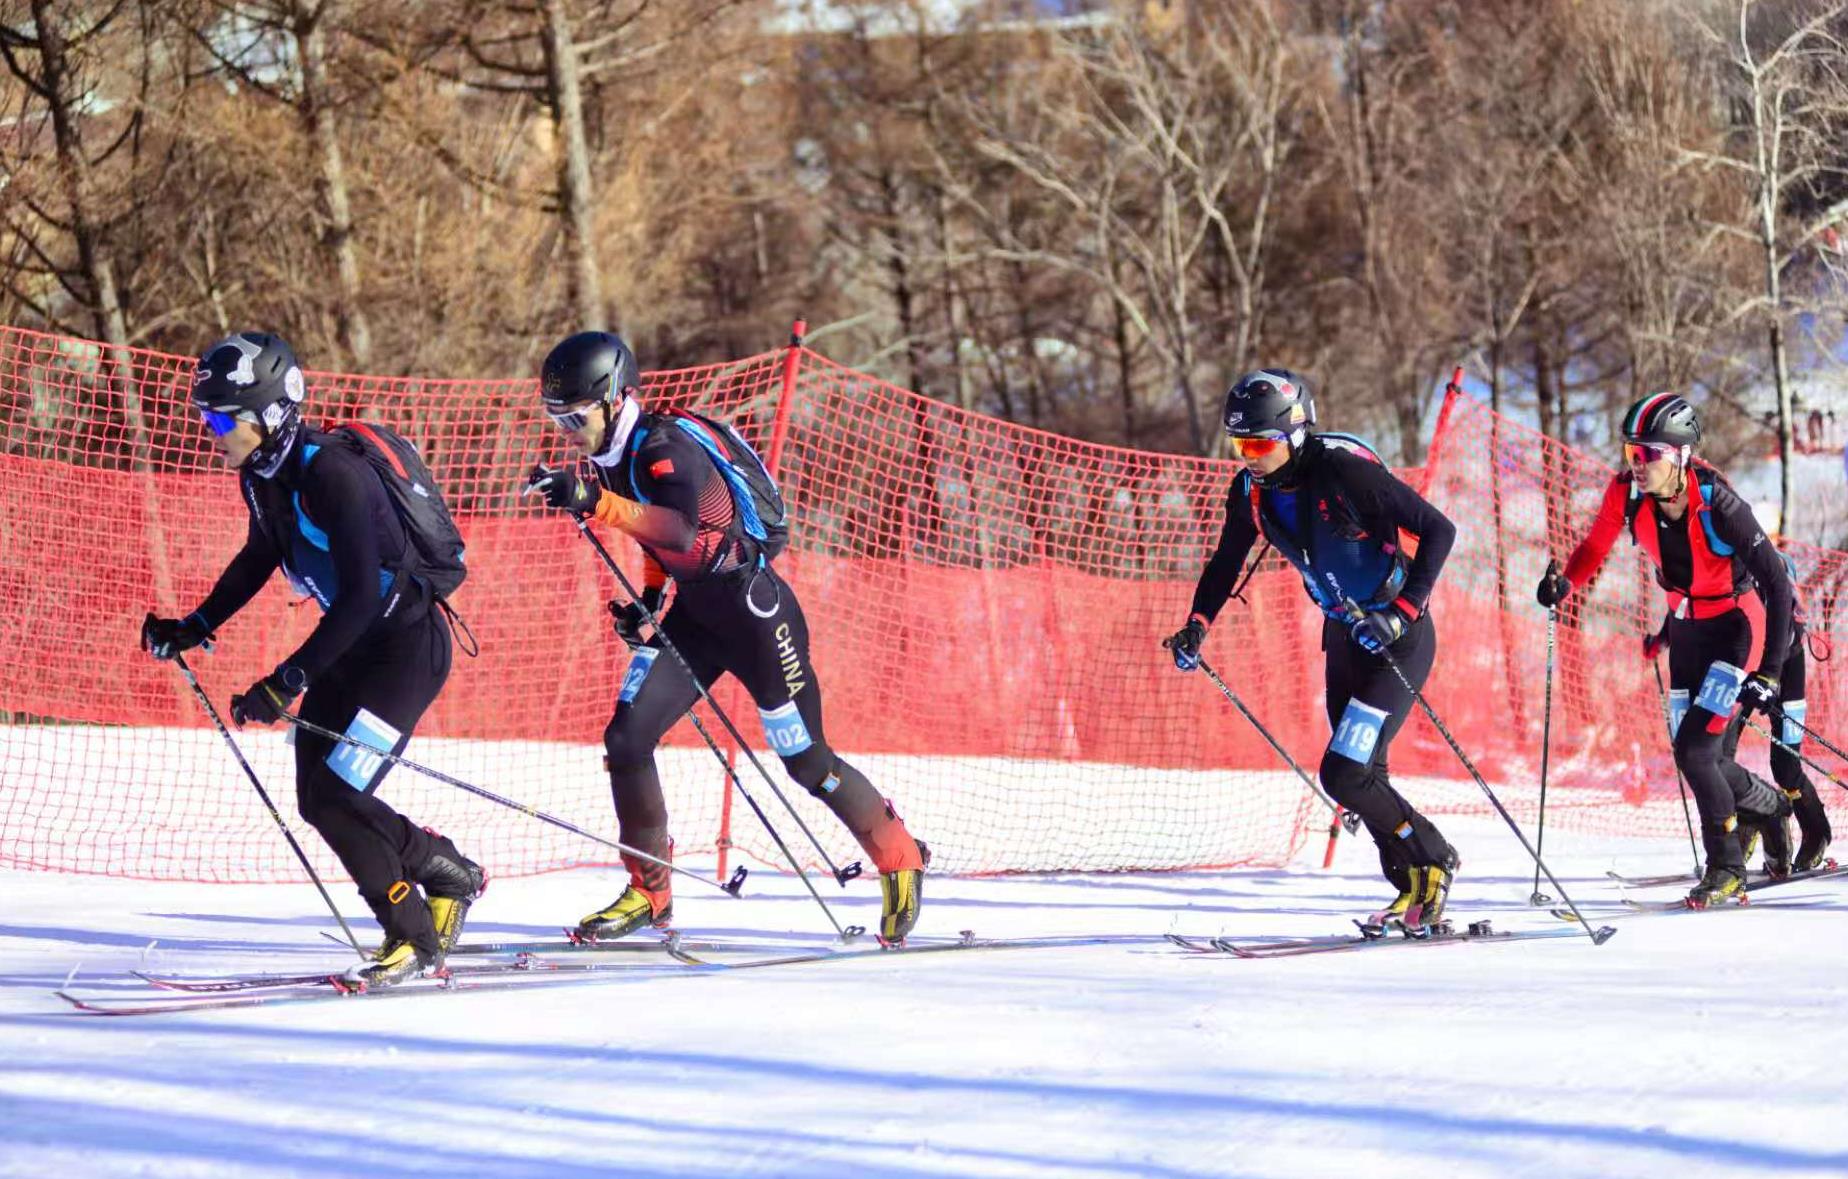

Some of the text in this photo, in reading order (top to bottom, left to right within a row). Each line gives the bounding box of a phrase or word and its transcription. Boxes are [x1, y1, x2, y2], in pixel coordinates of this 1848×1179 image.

[775, 623, 806, 698] CHINA
[766, 723, 807, 749] 102
[1338, 717, 1376, 752] 119
